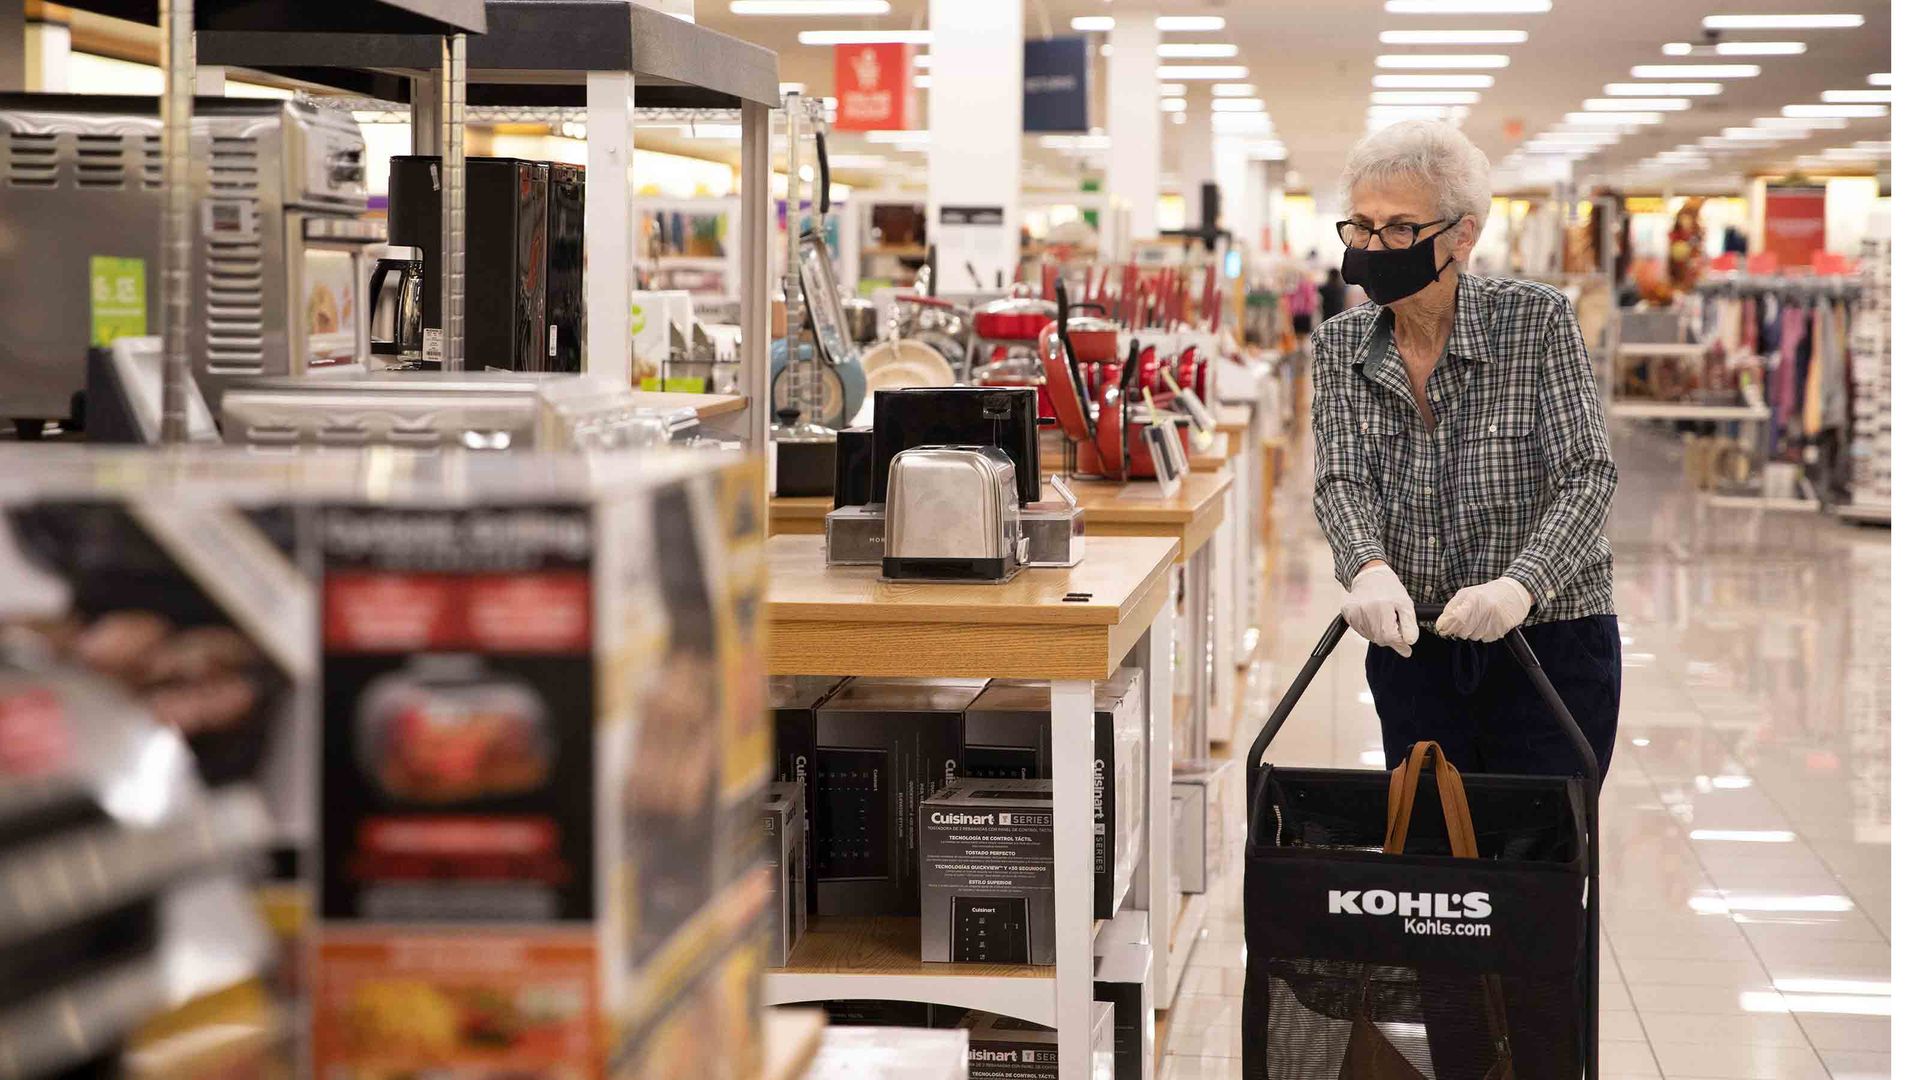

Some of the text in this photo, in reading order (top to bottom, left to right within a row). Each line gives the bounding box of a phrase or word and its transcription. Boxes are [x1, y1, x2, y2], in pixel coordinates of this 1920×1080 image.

[1094, 758, 1105, 818] Cuisinart
[931, 812, 994, 825] Cuisinart
[1013, 815, 1050, 824] SERIES
[1328, 889, 1492, 918] KOHL'S
[1404, 918, 1491, 936] Kohls.com
[1036, 1053, 1056, 1061] SER
